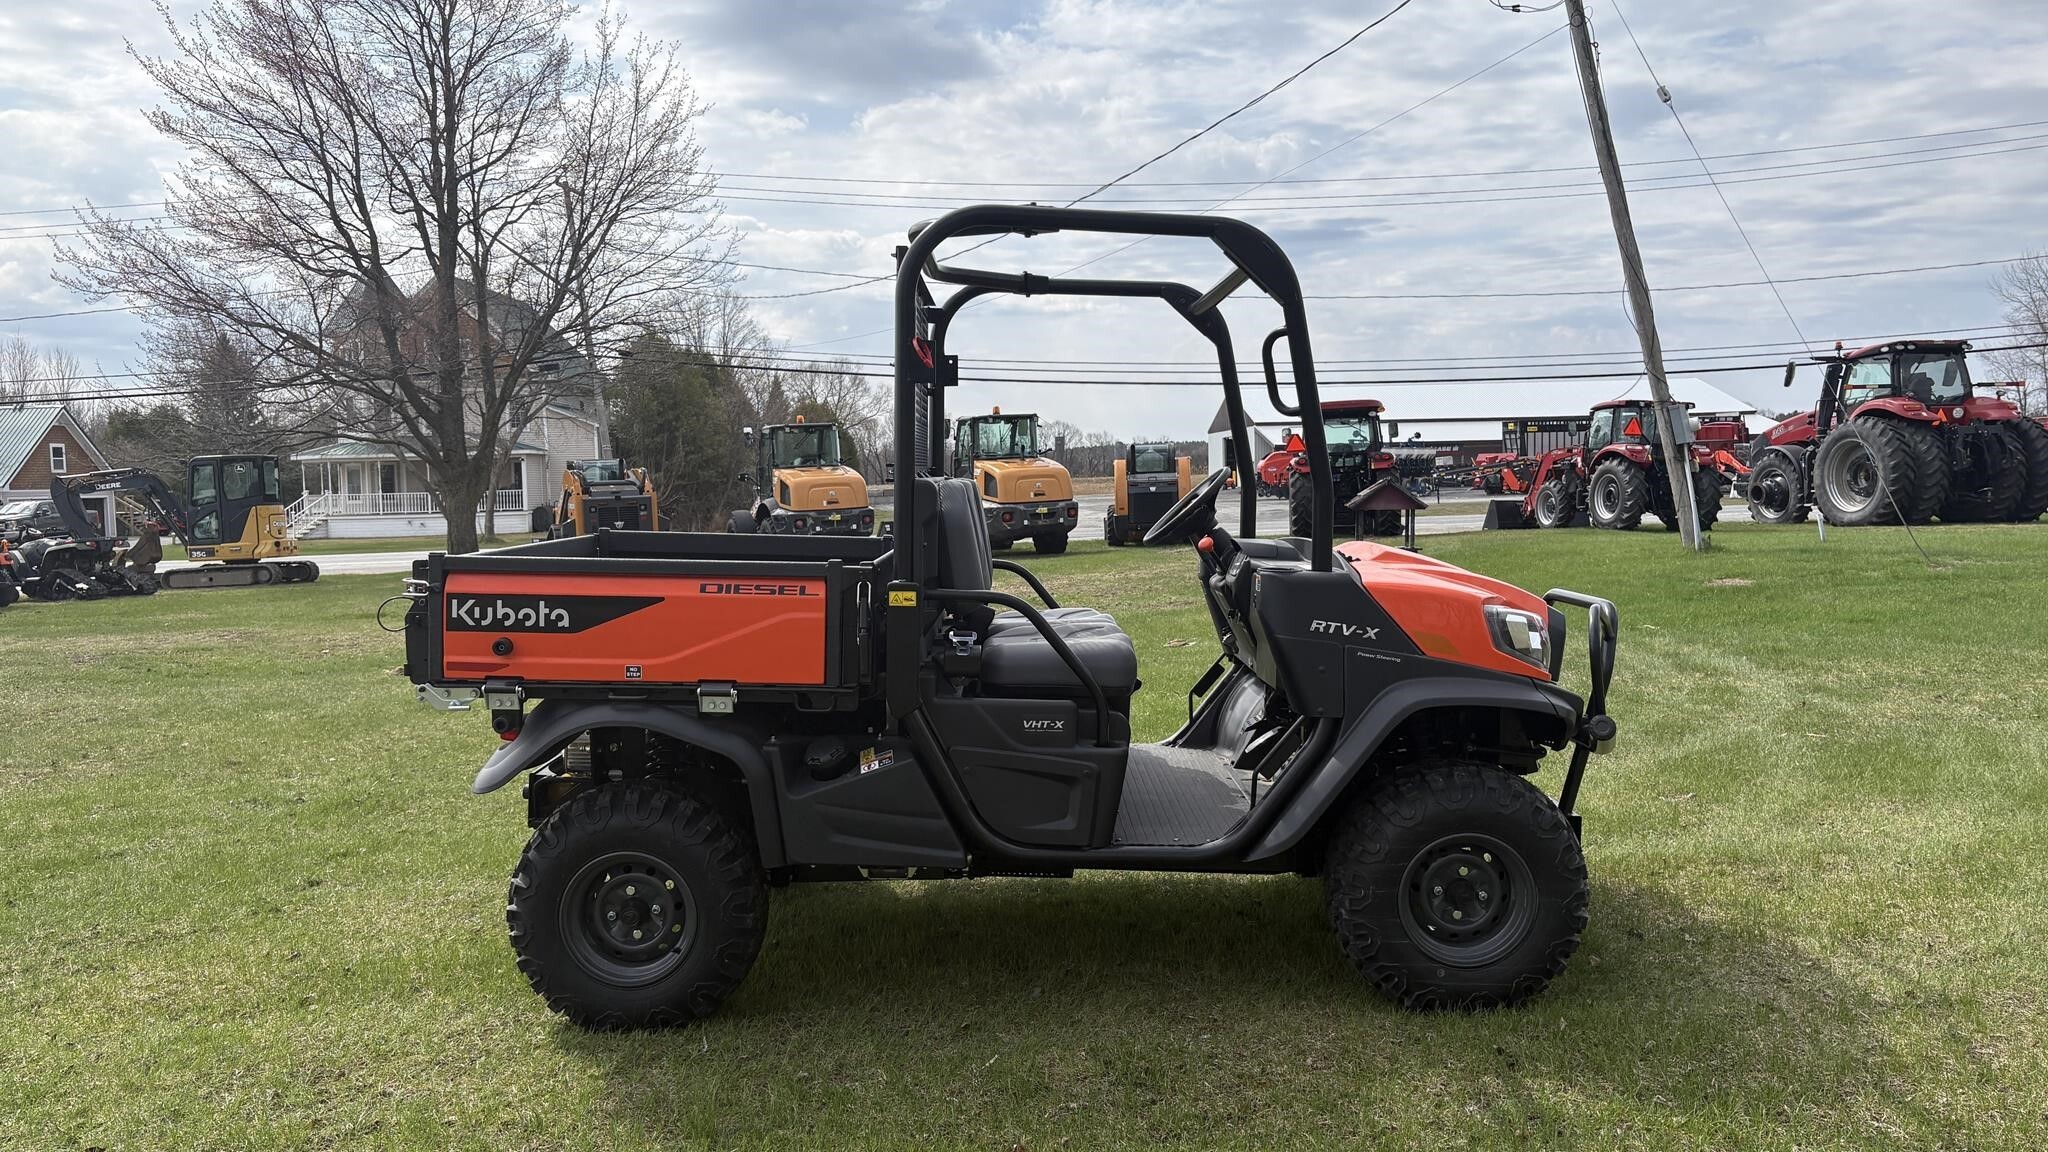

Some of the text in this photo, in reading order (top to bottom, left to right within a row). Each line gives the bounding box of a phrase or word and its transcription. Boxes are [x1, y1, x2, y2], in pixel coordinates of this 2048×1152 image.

[94, 481, 121, 490] DEERE
[699, 583, 820, 596] DIESEL
[451, 599, 570, 628] Kubota
[1309, 619, 1380, 640] RTV-X
[1375, 653, 1401, 663] Steering
[1023, 720, 1065, 729] VHT-X
